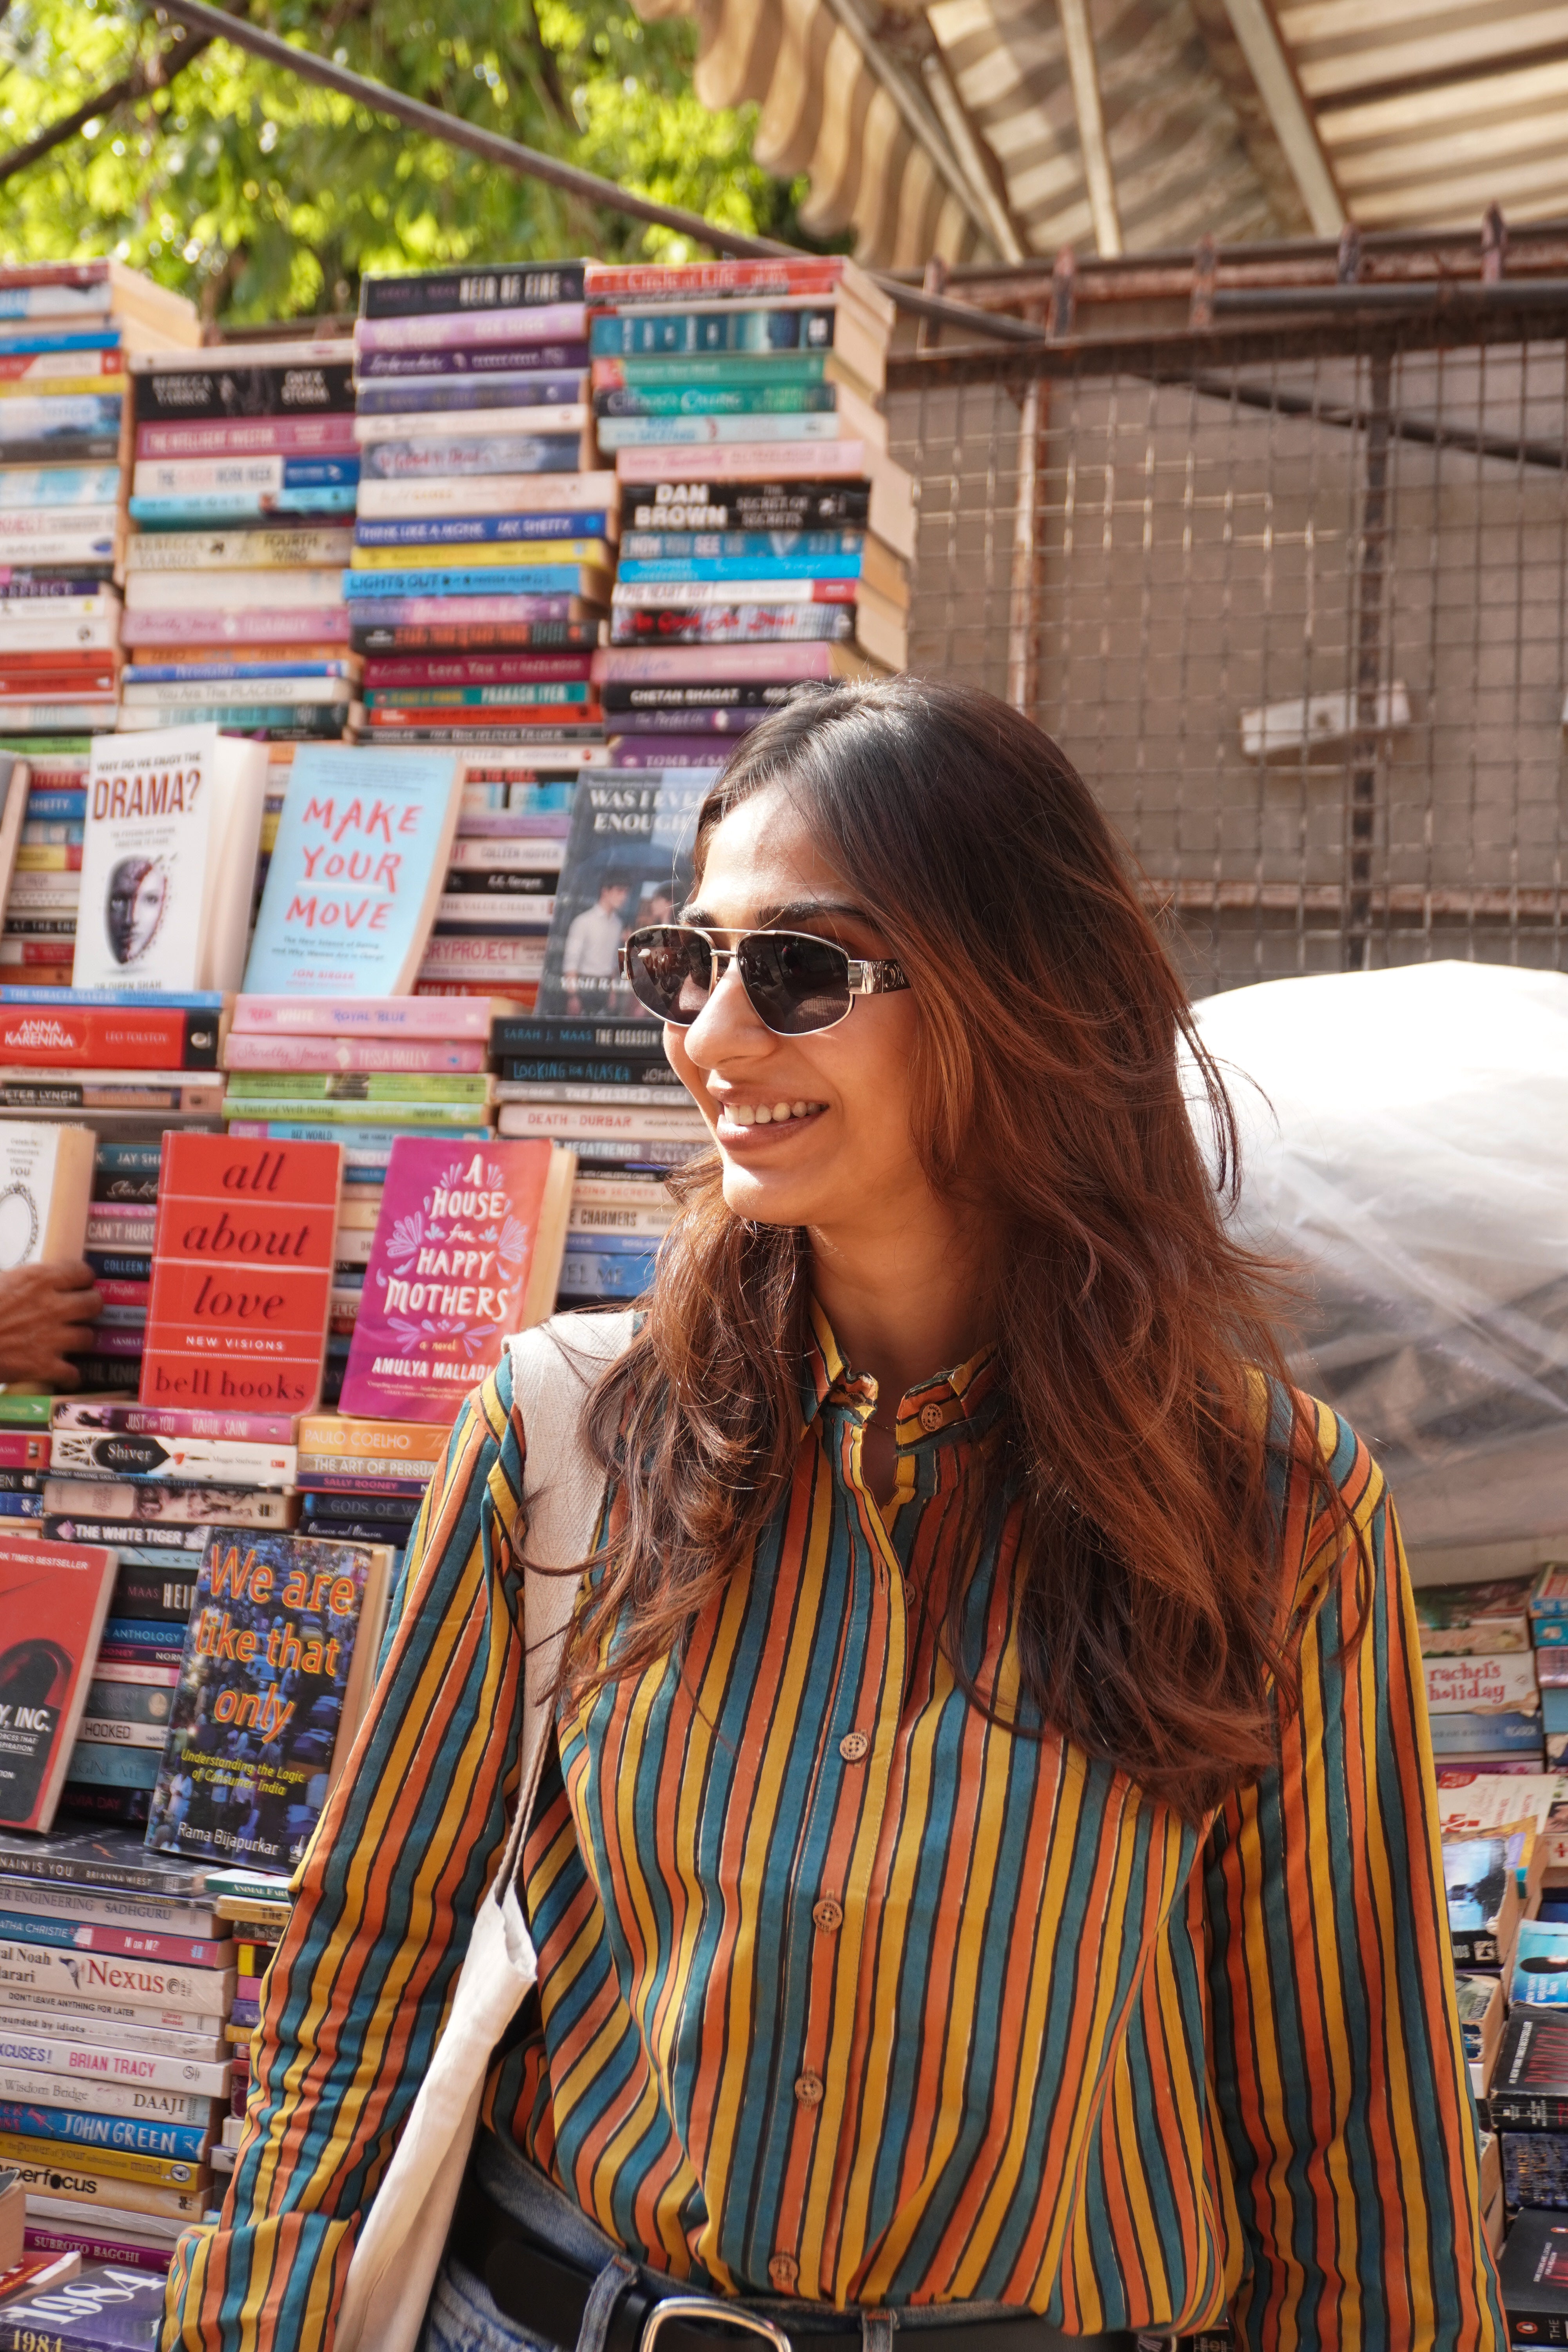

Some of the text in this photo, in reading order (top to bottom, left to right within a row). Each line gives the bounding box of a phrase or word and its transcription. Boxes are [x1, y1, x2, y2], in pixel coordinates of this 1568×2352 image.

[655, 484, 710, 505] DAN
[635, 506, 728, 527] BROWN
[630, 687, 739, 702] CHETAN BHAGAT
[184, 751, 201, 763] THE
[92, 769, 201, 821] DRAMA?
[590, 790, 636, 808] WAS
[302, 796, 423, 844] MAKE
[302, 844, 402, 895] YOUR
[285, 894, 394, 931] MOVE
[19, 1019, 61, 1033] ANNA
[5, 1029, 75, 1048] KARENINA
[513, 1061, 631, 1082] LOOKING ALASKA
[40, 1089, 78, 1100] LYNCH
[528, 1112, 632, 1127] DEATH DURBAR
[118, 1152, 138, 1164] JAY
[10, 1167, 31, 1176] YOU
[223, 1151, 286, 1192] all
[464, 1154, 483, 1188] A
[431, 1186, 506, 1221] HOUSE
[581, 1209, 637, 1227] CHARMERS
[88, 1222, 155, 1241] CAN'T HURT
[182, 1213, 309, 1256] about
[445, 1223, 476, 1244] for
[104, 1259, 143, 1272] COLLEEN
[416, 1247, 496, 1280] HAPPY
[194, 1274, 285, 1319] love
[383, 1276, 509, 1323] MOTHERS
[186, 1336, 284, 1351] NEW VISIONS
[432, 1339, 456, 1351] novel
[372, 1356, 429, 1378] AMULYA
[156, 1367, 305, 1400] bell hooks
[125, 1413, 249, 1436] JUST YOU RAHUL SAINI
[304, 1430, 410, 1450] PAULO COELHO
[107, 1443, 152, 1463] Shiver
[50, 1469, 120, 1481] MONEY MAKING SKILLS
[314, 1457, 437, 1477] THE ART OF PERSUA
[323, 1477, 398, 1490] SALLY ROONEY
[331, 1500, 369, 1514] GODS
[75, 1524, 183, 1544] THE WHITE TIGER
[10, 1553, 34, 1564] TIMES
[35, 1555, 89, 1571] BESTSELLER
[209, 1543, 355, 1616] We are
[127, 1585, 160, 1599] MAAS
[112, 1628, 180, 1643] ANTHOLOGY
[194, 1610, 340, 1678] like that
[1428, 1660, 1501, 1682] rachel's
[1428, 1679, 1506, 1704] holiday
[14, 1707, 52, 1732] INC.
[213, 1682, 296, 1744] only
[20, 1736, 38, 1744] THAT
[85, 1722, 131, 1739] HOOKED
[181, 1746, 306, 1786] Understanding the Logic
[191, 1767, 287, 1796] of Consumer India
[177, 1821, 279, 1858] Rama Bijapurkar
[32, 1862, 151, 1886] IS YOU BRIANNA WIEST
[234, 1884, 263, 1894] ANIMAL
[15, 1889, 172, 1921] ENGINEERING SADHGURU
[261, 1907, 282, 1920] The
[25, 1922, 69, 1938] CHRISTIE
[16, 1949, 51, 1966] Noah
[0, 1966, 36, 1984] arari
[85, 1959, 165, 1995] Nexus
[8, 1992, 135, 2018] DON'T LEAVE ANYTHING FOR LATER
[41, 2019, 54, 2031] by
[162, 2011, 182, 2021] Library
[68, 2051, 109, 2072] BRIAN
[114, 2057, 156, 2078] TRACY
[4, 2078, 50, 2096] Wisdom
[53, 2084, 89, 2102] Bridge
[132, 2093, 187, 2116] DAAJI
[58, 2112, 178, 2155] JOHN GREEN
[34, 2235, 140, 2264] SUBROTO BAGCHI
[0, 2269, 166, 2325] 1984
[1549, 2318, 1561, 2339] THE
